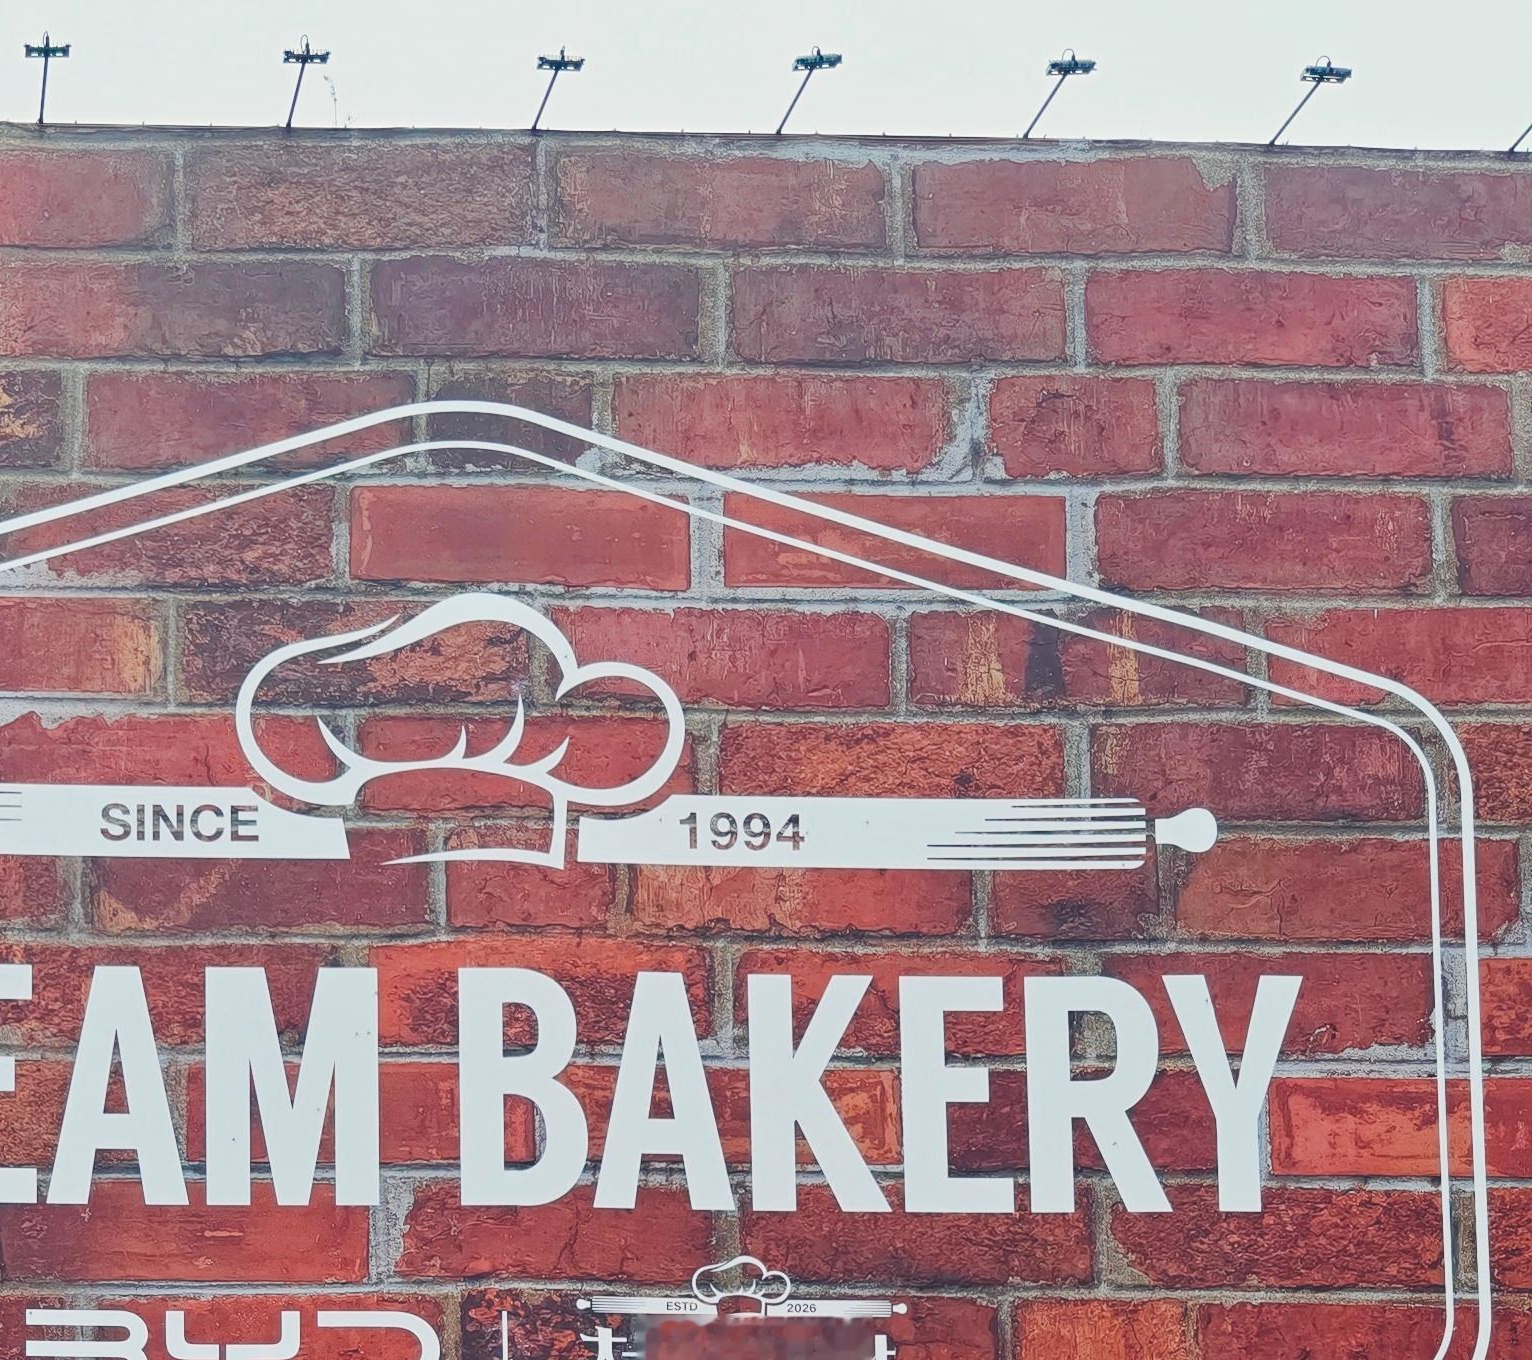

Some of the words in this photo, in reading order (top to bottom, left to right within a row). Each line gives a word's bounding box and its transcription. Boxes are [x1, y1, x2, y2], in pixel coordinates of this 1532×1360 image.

[100, 802, 260, 843] SINCE
[679, 811, 805, 851] 1994
[459, 968, 1302, 1213] BAKERY
[666, 1301, 698, 1312] ESTD
[786, 1302, 817, 1314] 2026
